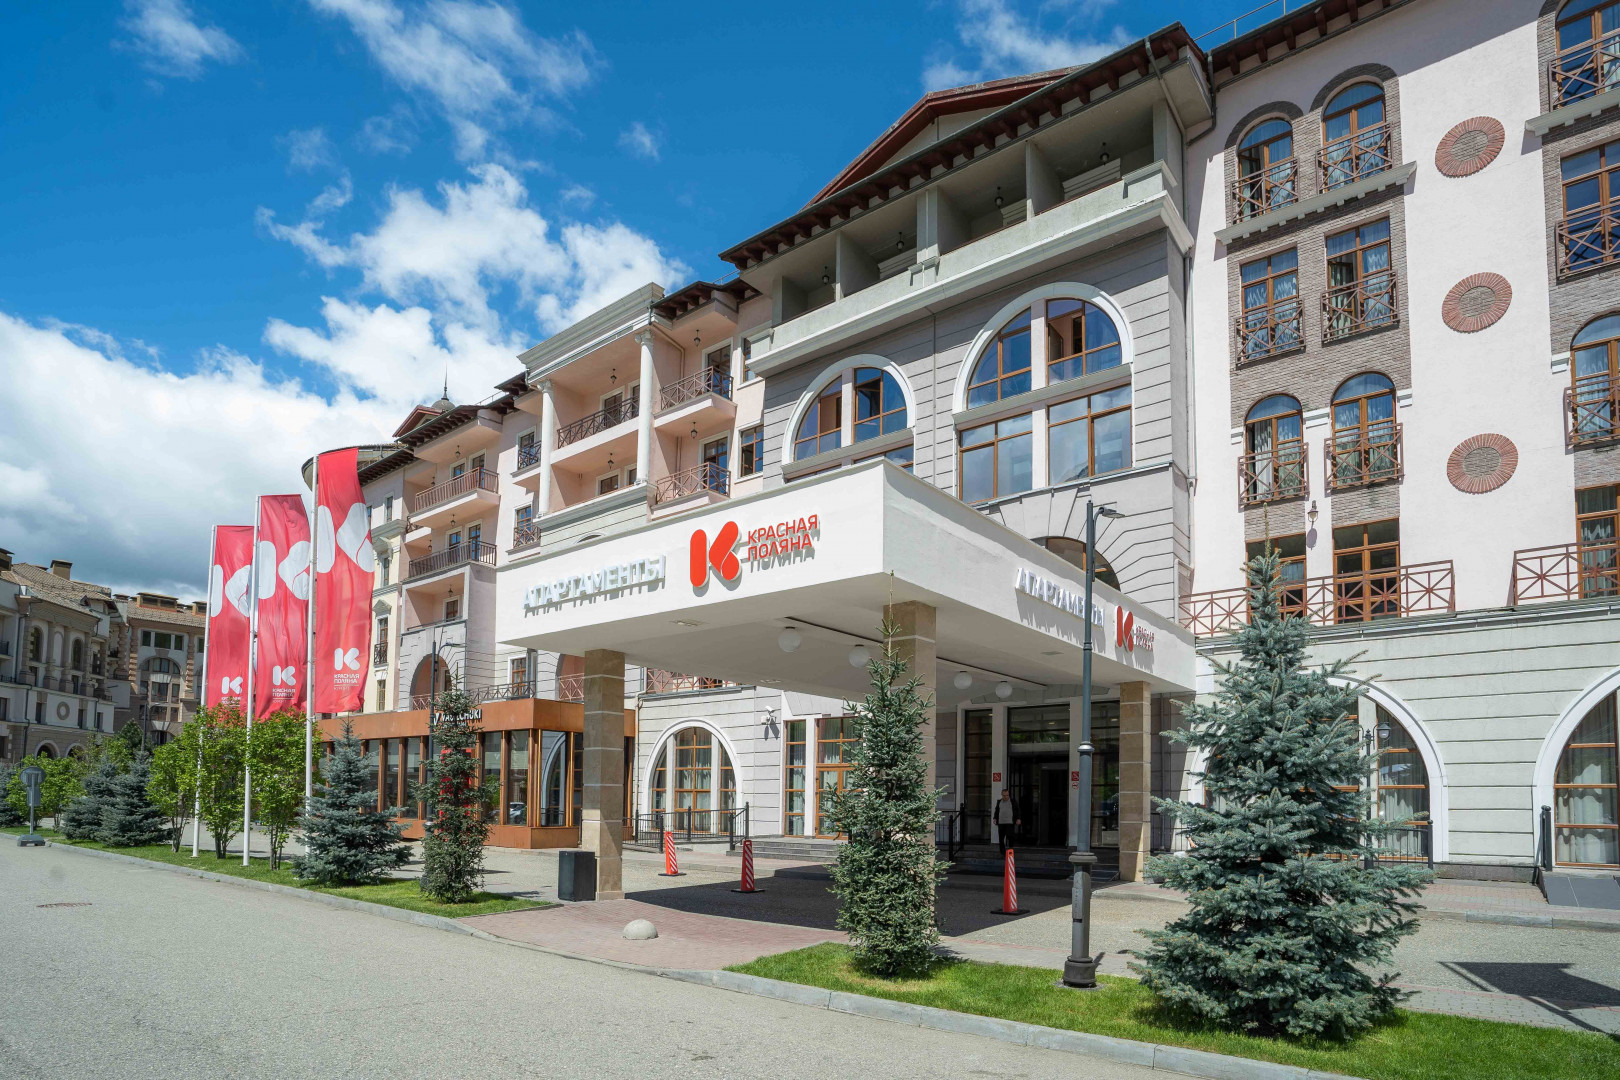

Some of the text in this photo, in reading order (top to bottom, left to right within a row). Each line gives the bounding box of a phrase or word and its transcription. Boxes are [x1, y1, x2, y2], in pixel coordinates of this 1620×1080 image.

[748, 514, 818, 543] КРАСНАЯ
[747, 531, 812, 560] ПОЛЯНА
[523, 554, 666, 610] АПАРТАМЕНТЫ
